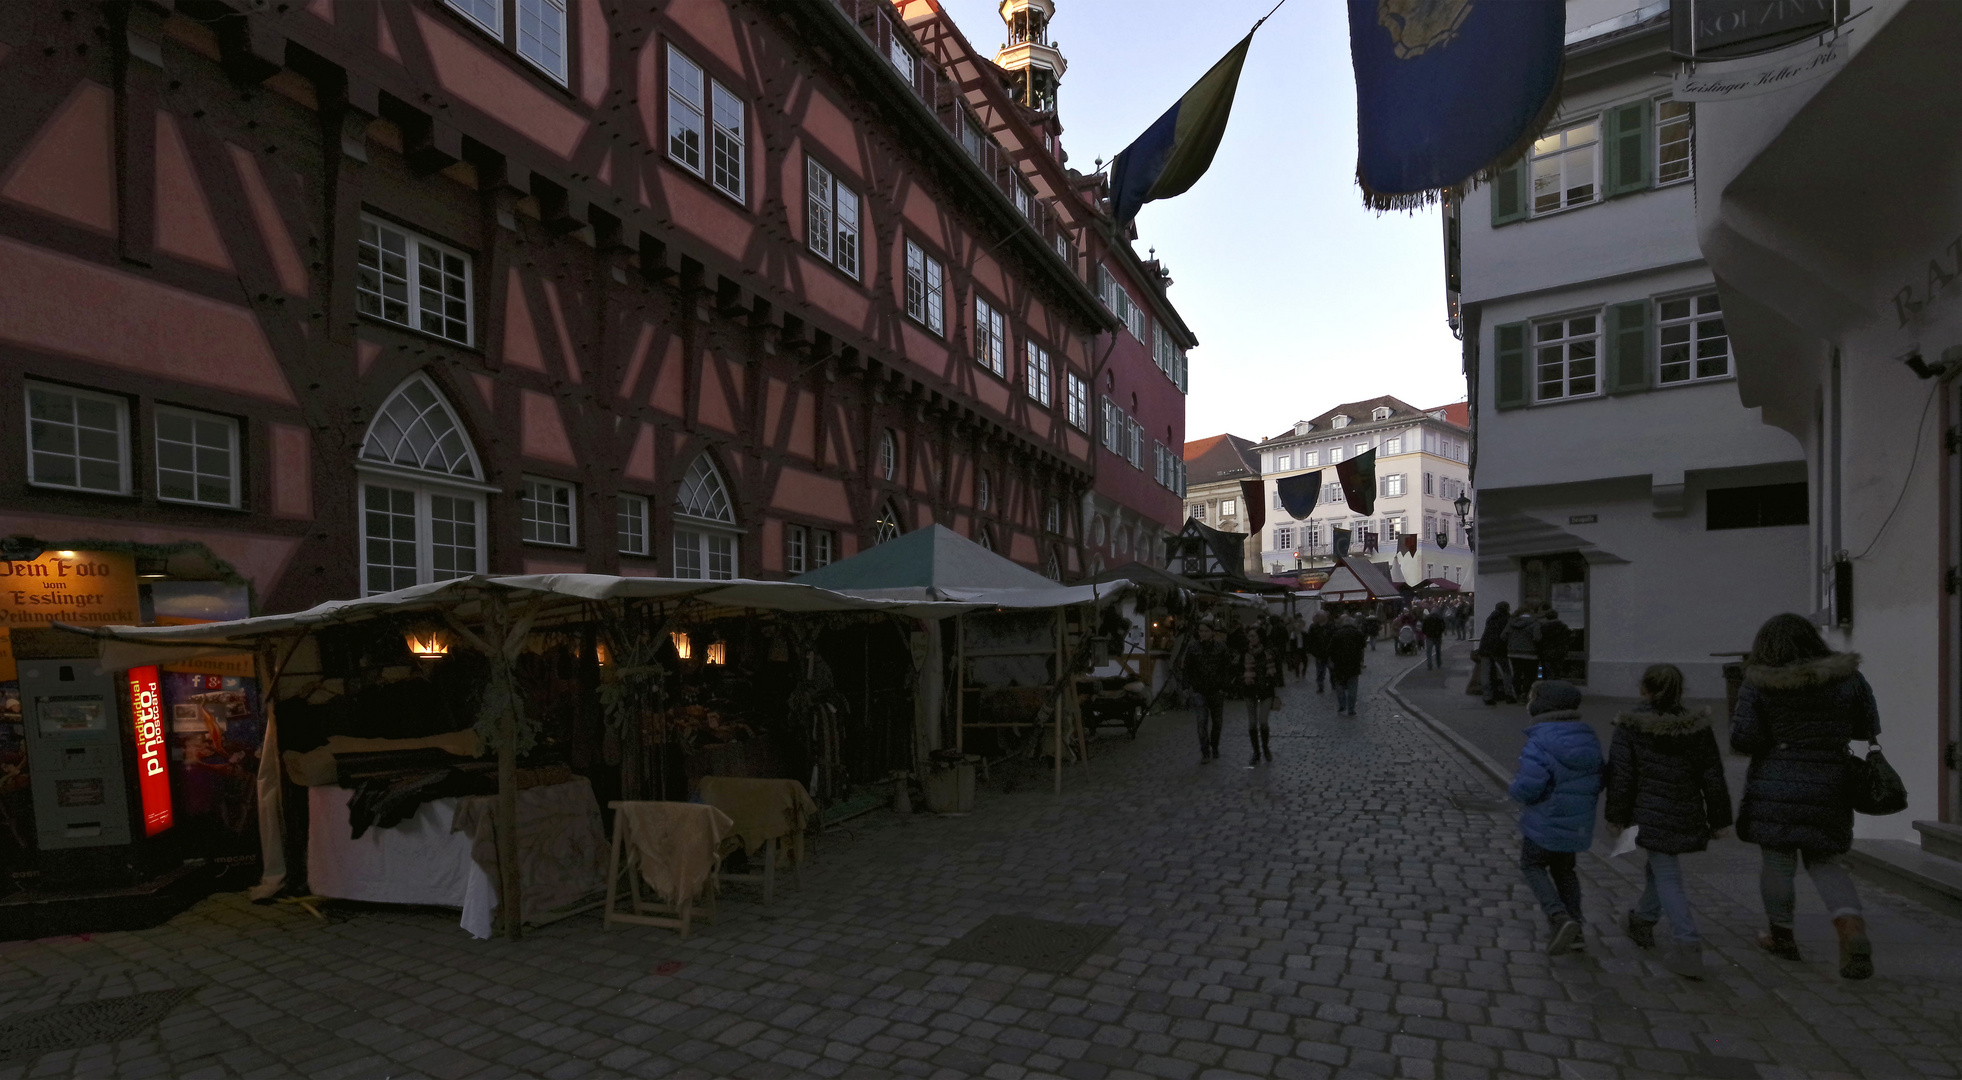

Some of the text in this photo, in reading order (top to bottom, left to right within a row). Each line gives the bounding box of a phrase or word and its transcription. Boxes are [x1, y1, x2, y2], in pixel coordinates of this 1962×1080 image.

[1682, 48, 1837, 95] Geislinger Keller Pils
[42, 581, 67, 589] vom
[49, 557, 110, 577] Foto
[9, 591, 104, 608] Esslinger
[130, 680, 145, 746] individual
[140, 691, 164, 776] photo
[149, 682, 164, 744] postcard
